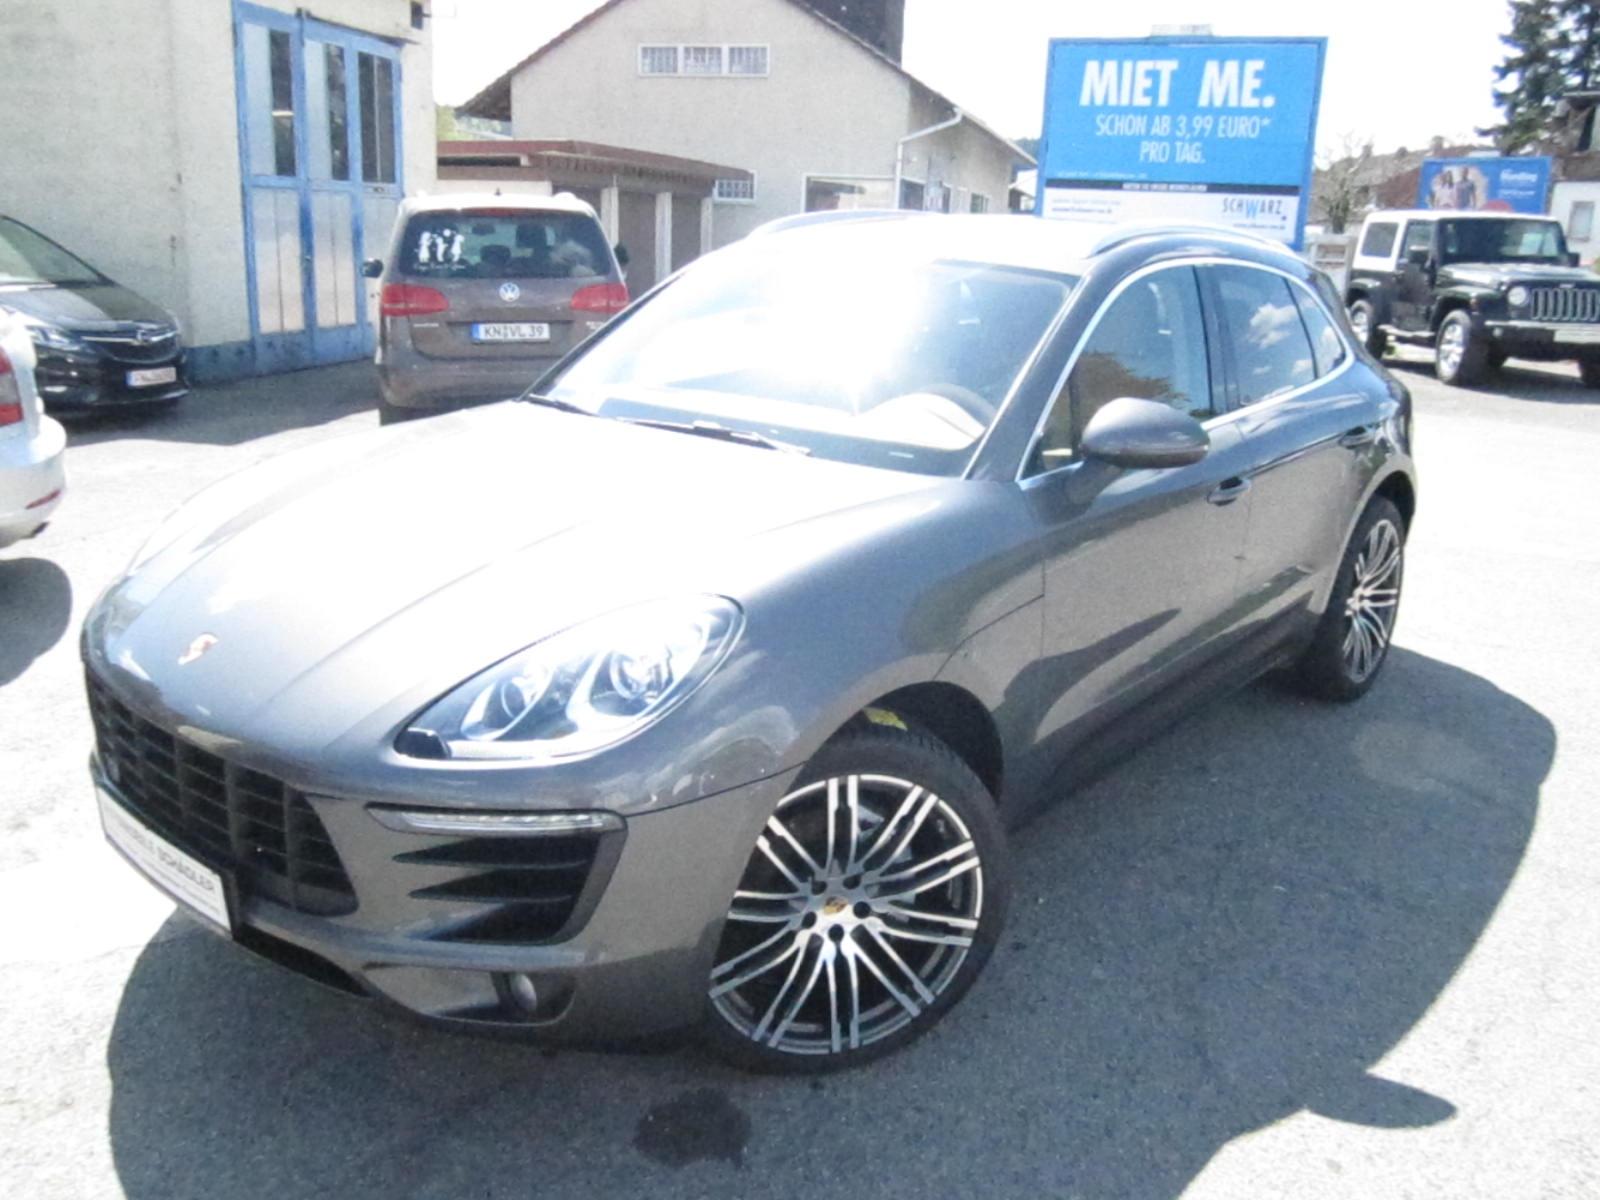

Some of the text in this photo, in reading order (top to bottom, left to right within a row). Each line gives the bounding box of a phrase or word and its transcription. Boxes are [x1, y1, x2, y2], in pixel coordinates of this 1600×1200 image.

[1078, 60, 1276, 108] MIET ME.
[1095, 113, 1148, 137] SCHON
[1151, 114, 1171, 137] AB
[1175, 114, 1214, 140] 3,99
[1139, 140, 1207, 164] PRO TAG.
[484, 325, 544, 338] KN VL 39
